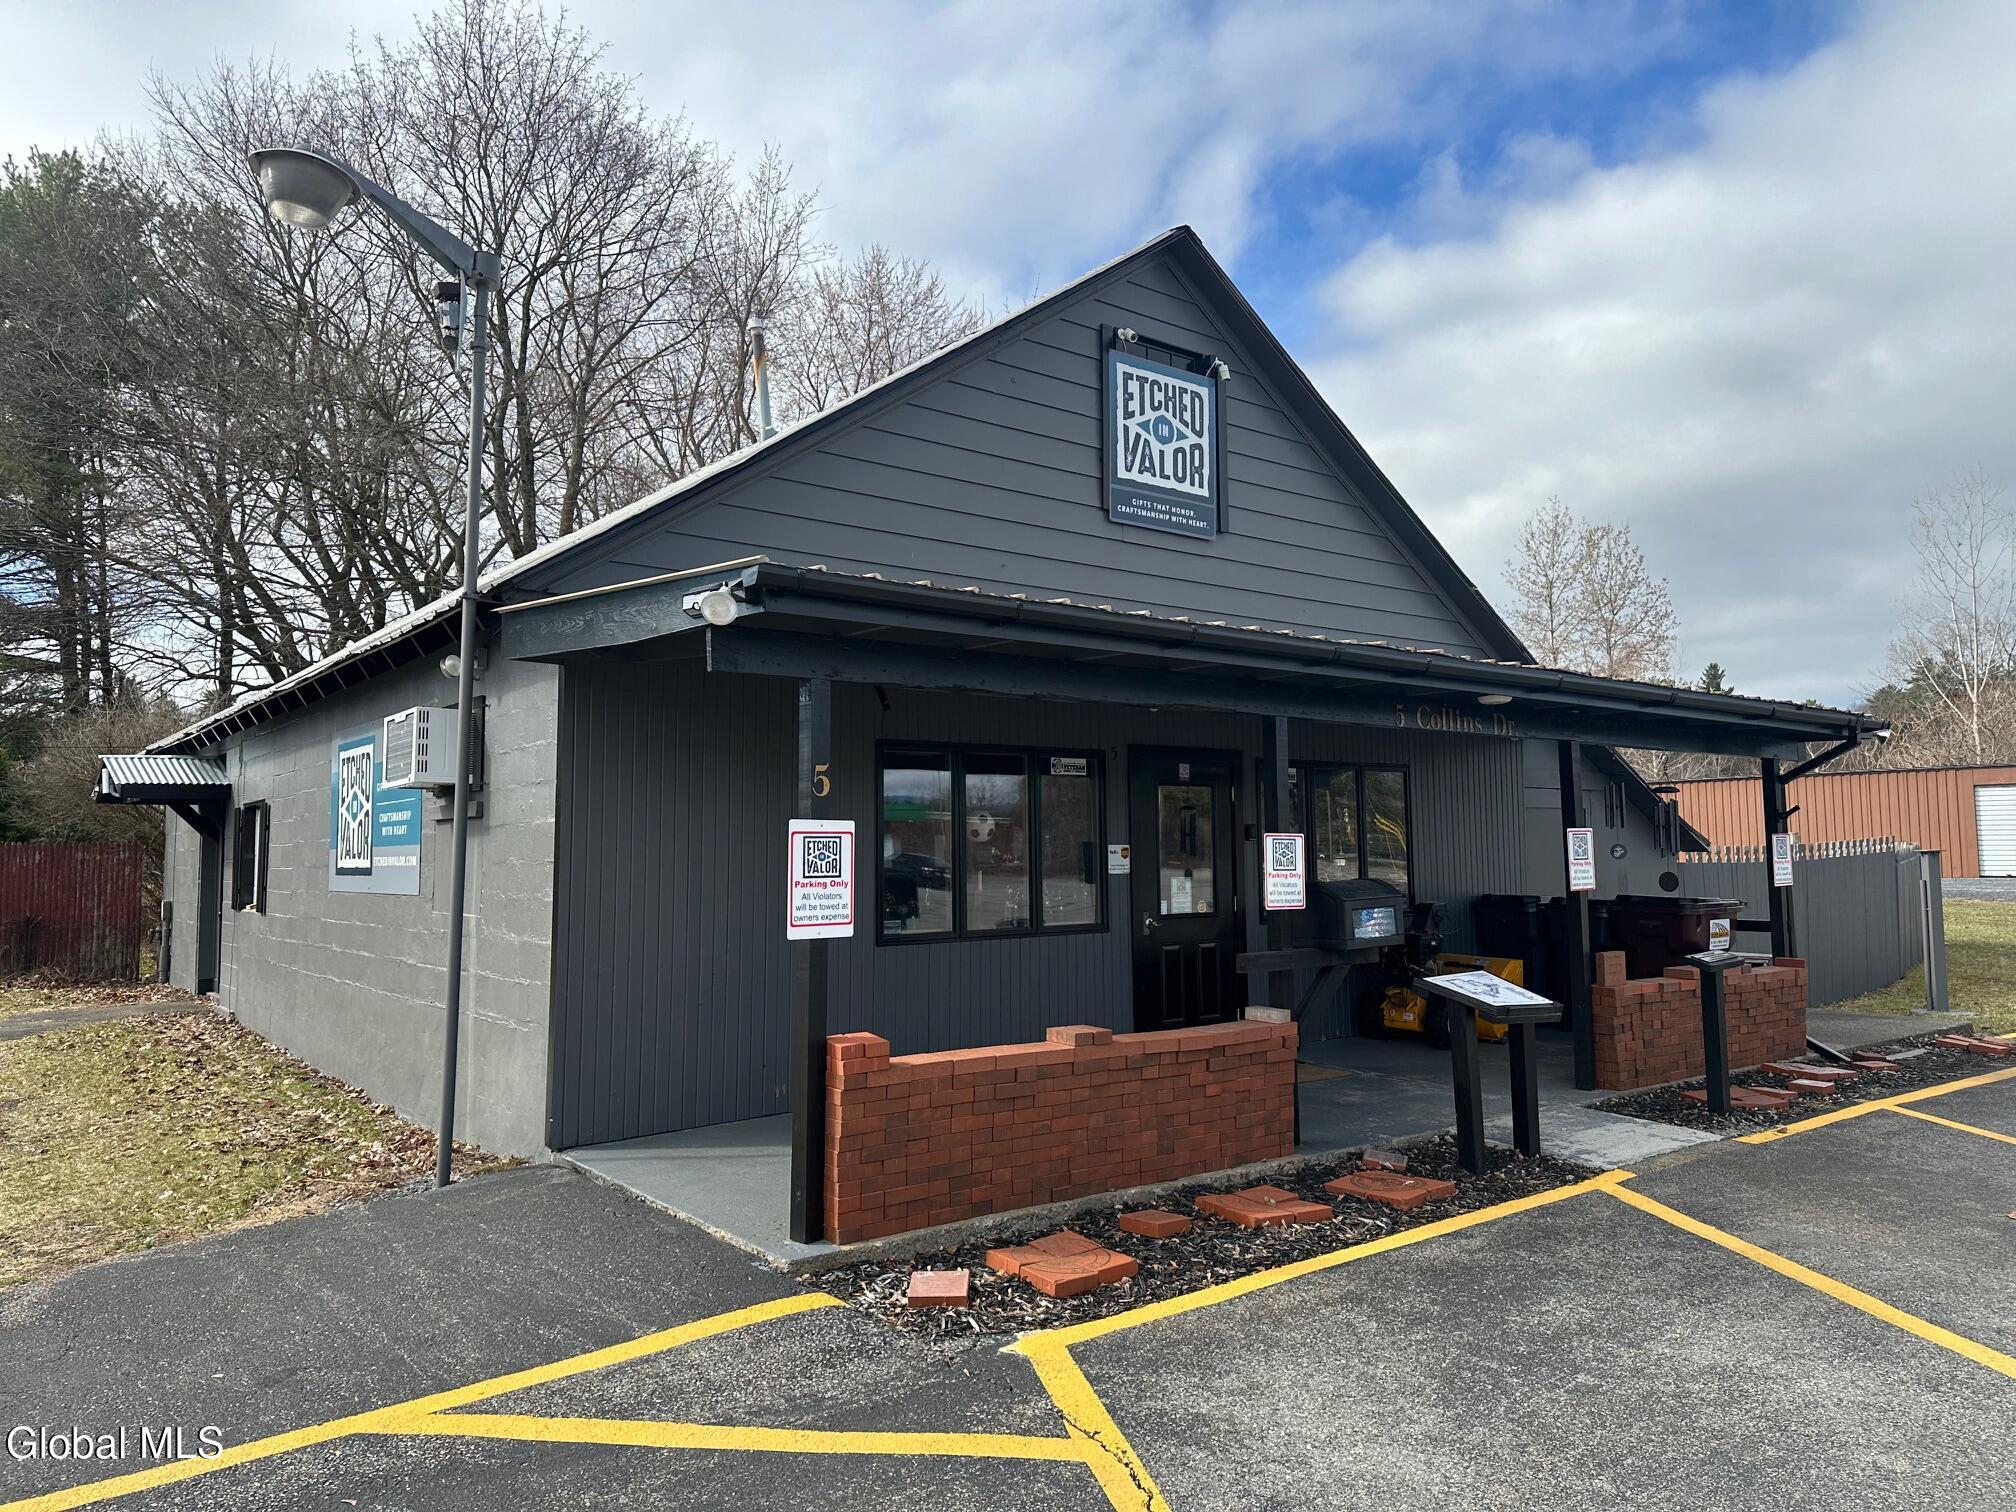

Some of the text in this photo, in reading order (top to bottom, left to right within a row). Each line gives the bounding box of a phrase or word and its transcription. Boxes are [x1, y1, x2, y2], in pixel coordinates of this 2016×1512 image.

[1123, 371, 1204, 439] ETCHED
[1159, 423, 1168, 437] IN
[1123, 423, 1204, 489] VALOR
[1132, 498, 1196, 518] GIFTS THAT HONOR.
[1117, 504, 1209, 529] CRAFTSMANSHIP WITH HEART.
[1394, 703, 1406, 728] 5
[1416, 705, 1483, 734] Collins
[341, 752, 371, 808] ETCHED
[812, 763, 831, 797] 5
[379, 810, 411, 823] CRAFTSMANSHIP
[340, 809, 370, 861] VALOR
[381, 825, 407, 836] WITH HEART
[807, 840, 838, 857] ETCHED
[1275, 842, 1294, 854] ETCHED
[807, 858, 838, 874] VALOR
[1275, 855, 1295, 868] VALOR
[794, 880, 849, 889] Parking Only
[813, 892, 843, 900] Violators
[795, 902, 849, 911] will be towed at
[793, 913, 850, 922] owners expense
